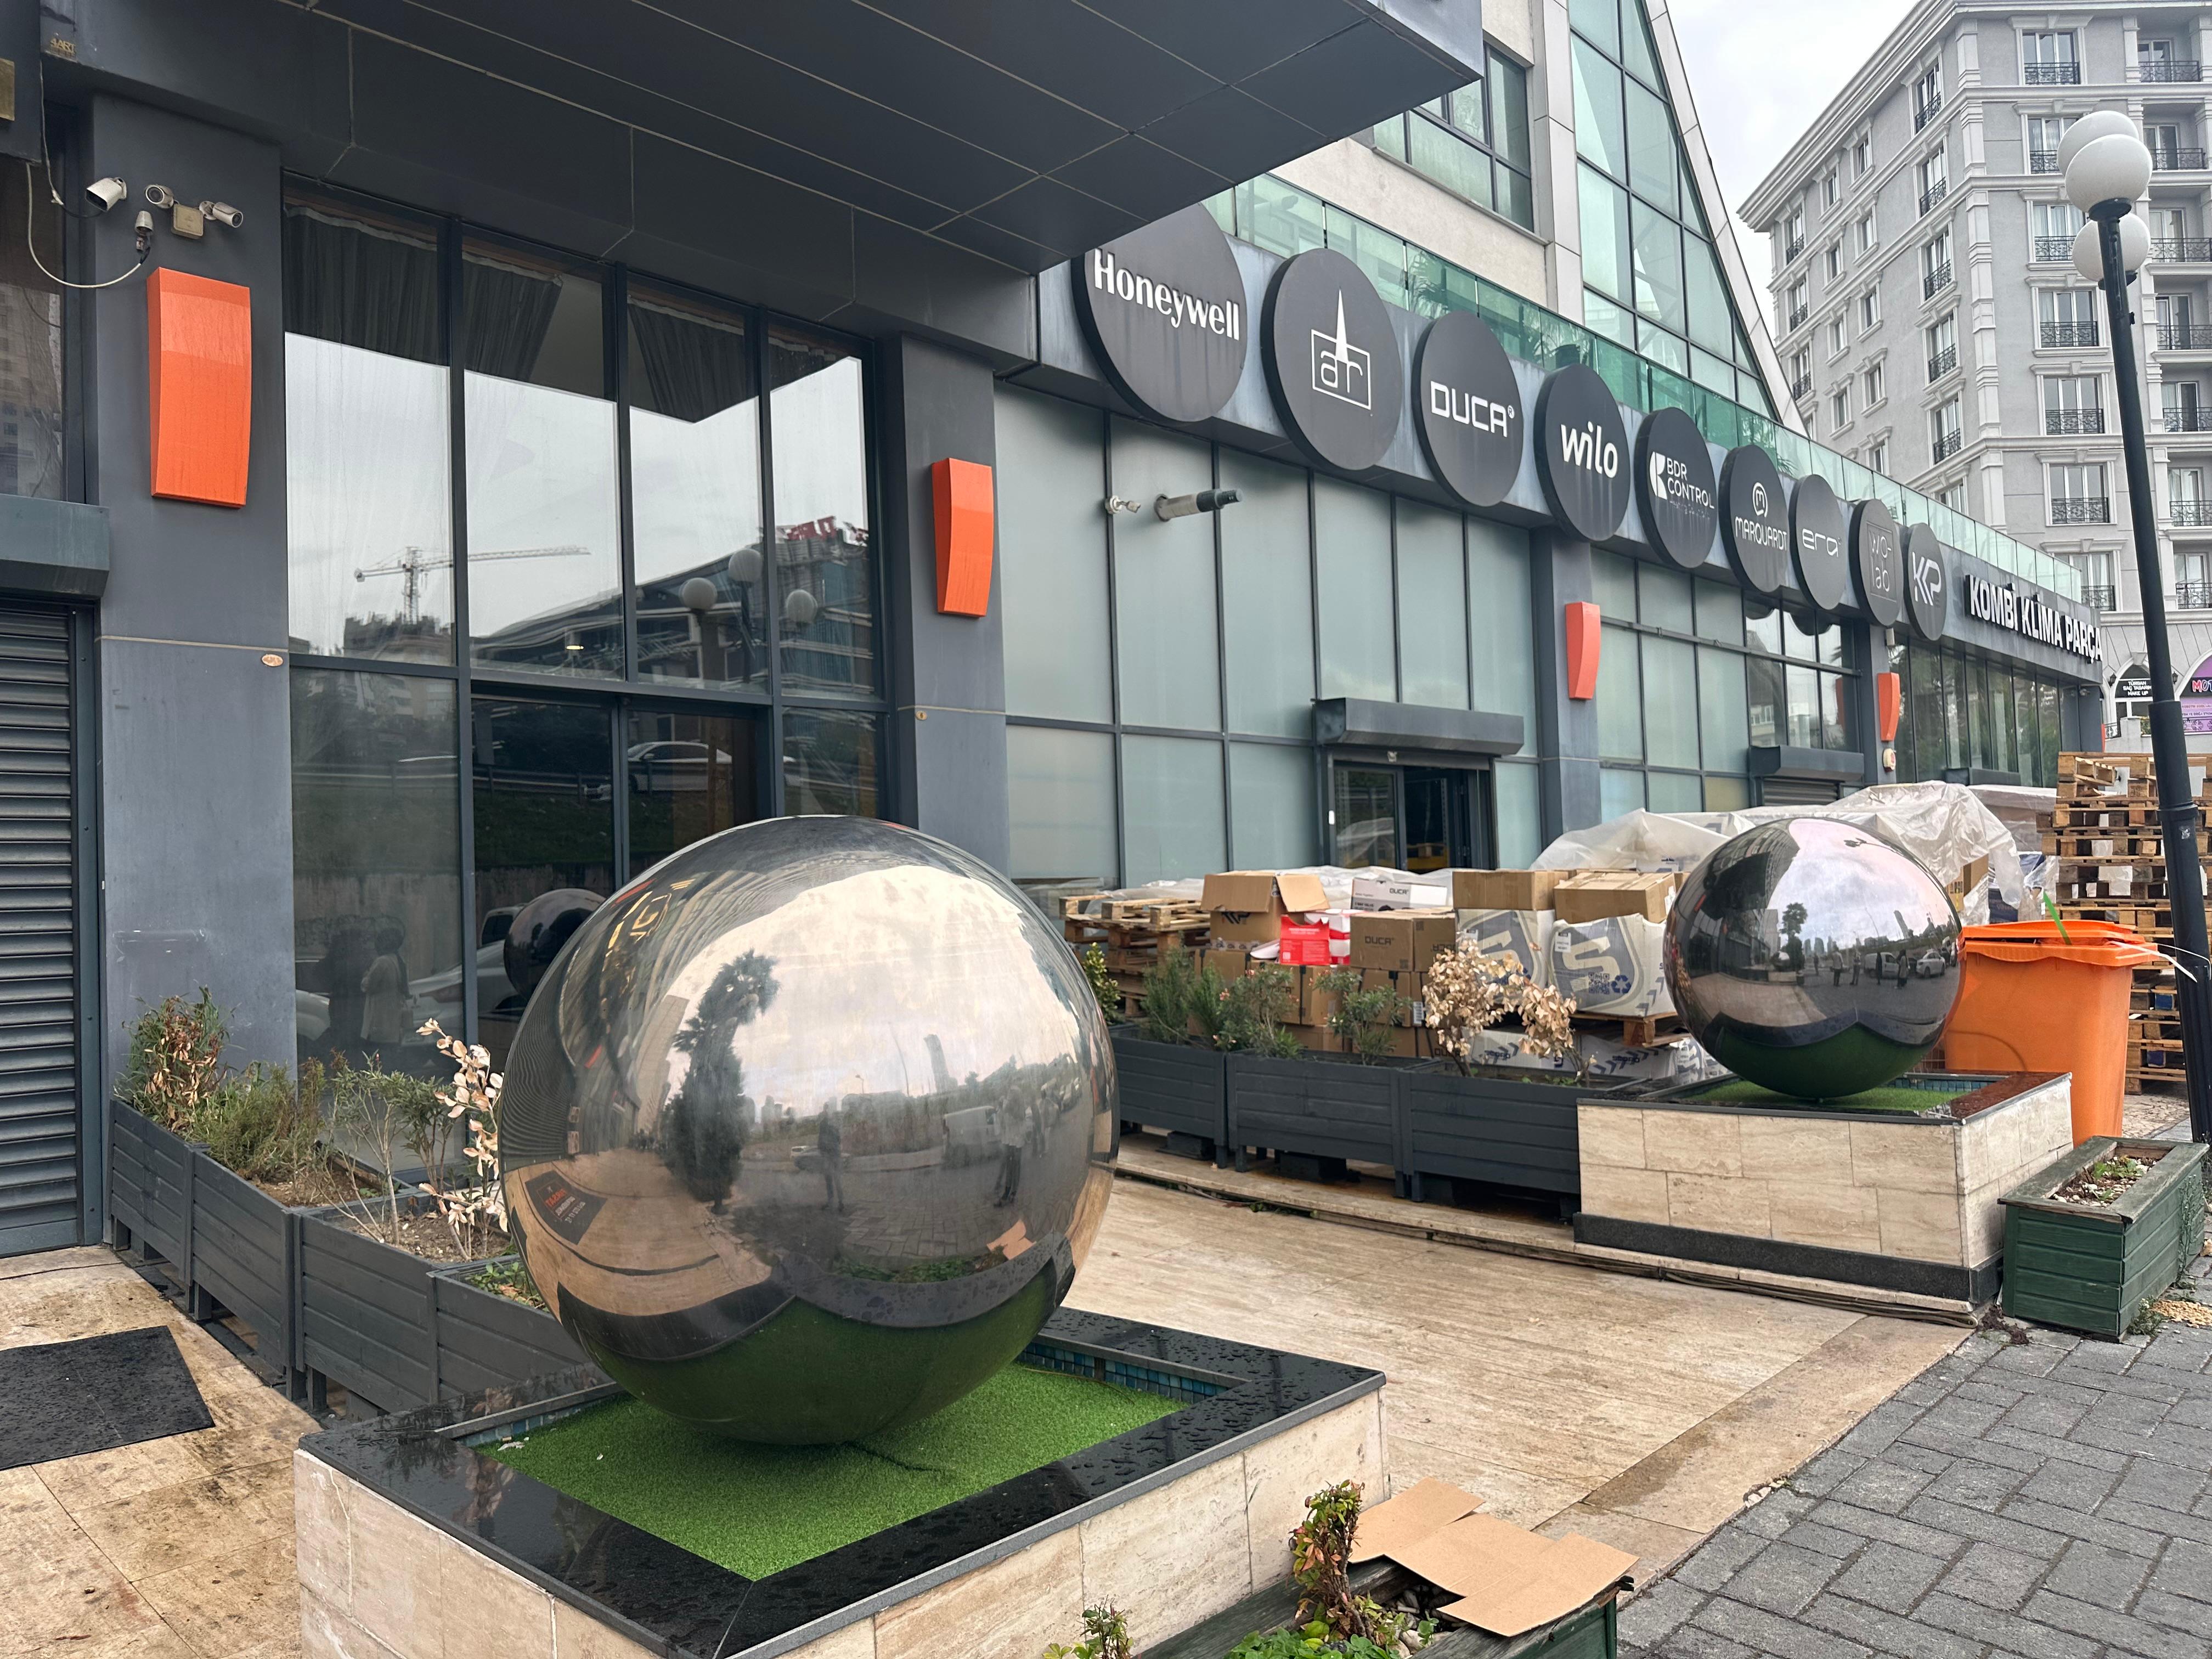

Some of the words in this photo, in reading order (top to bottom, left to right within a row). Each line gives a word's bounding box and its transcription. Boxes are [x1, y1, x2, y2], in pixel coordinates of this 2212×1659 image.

[1093, 249, 1241, 341] Honeywell
[1561, 421, 1618, 479] wilo
[1667, 458, 1688, 481] BDR
[1667, 478, 1715, 509] CONTROL
[1735, 516, 1787, 551] MARQUARDT
[2064, 614, 2103, 664] PARÇA
